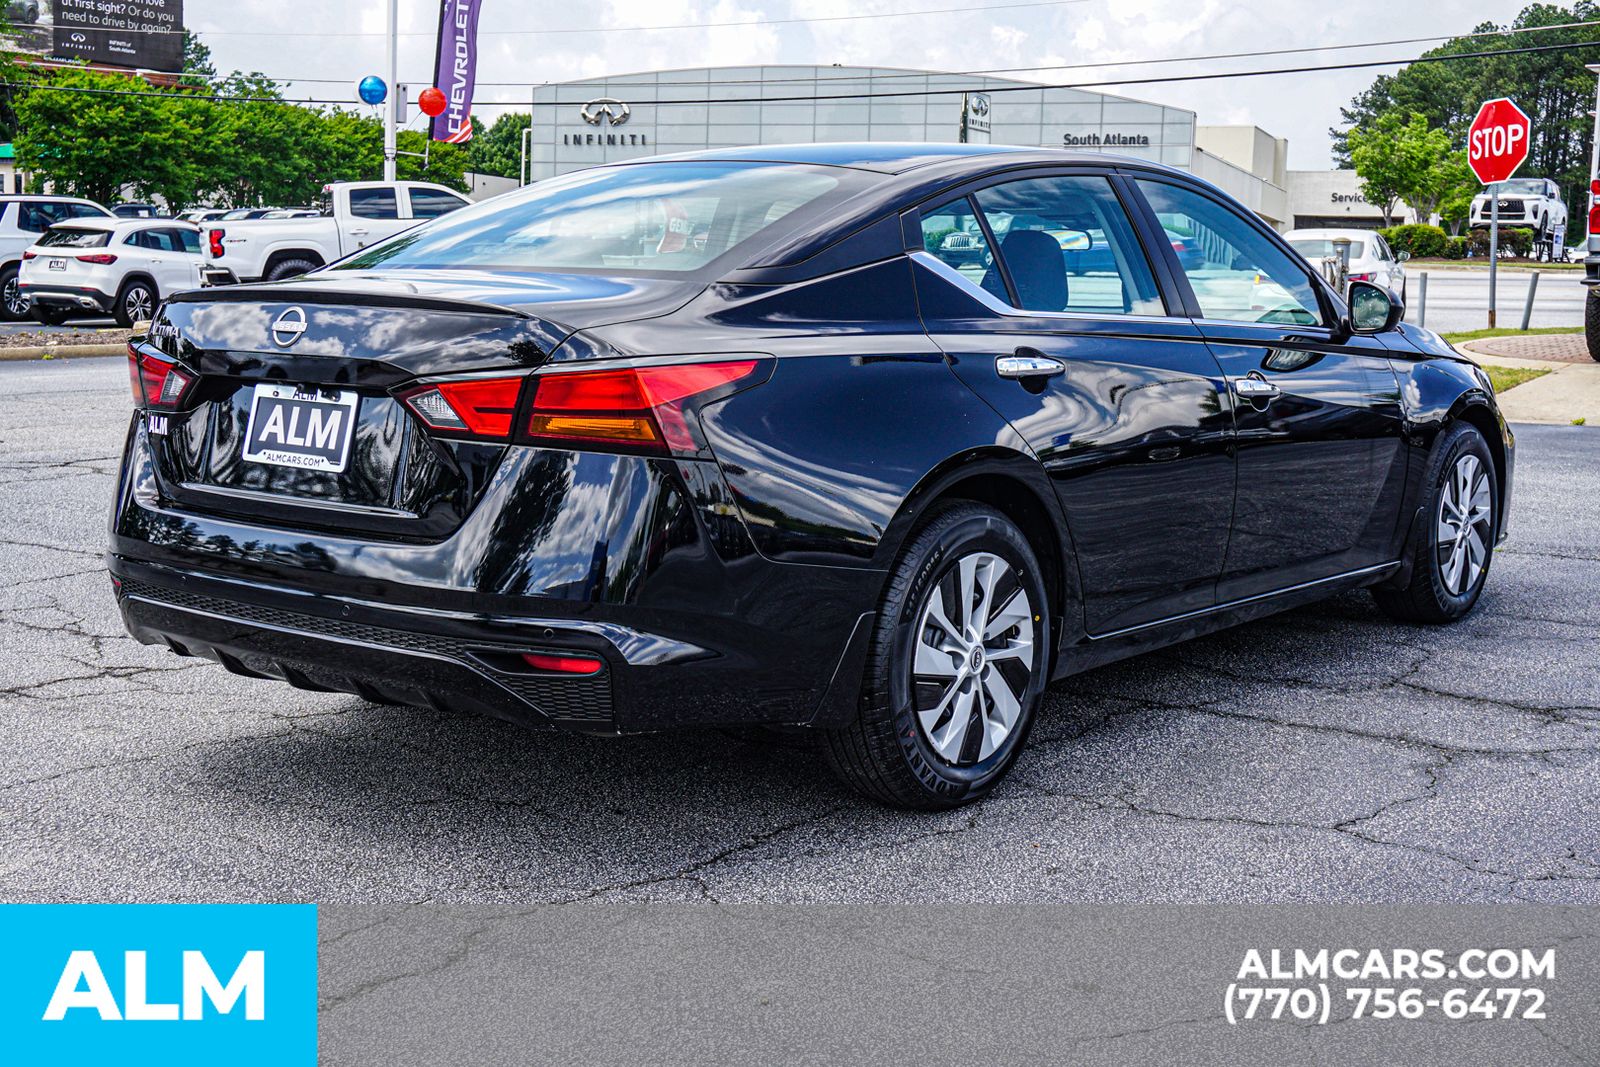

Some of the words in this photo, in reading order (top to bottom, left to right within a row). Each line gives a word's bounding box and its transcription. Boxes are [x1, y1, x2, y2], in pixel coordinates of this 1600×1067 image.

[74, 0, 95, 10] first
[97, 1, 126, 15] sight?
[128, 5, 141, 16] Or
[142, 8, 156, 19] do
[157, 12, 175, 23] you
[62, 11, 87, 23] need
[89, 14, 100, 25] to
[102, 15, 126, 29] drive
[127, 18, 140, 32] by
[141, 23, 172, 35] again?
[61, 42, 96, 51] INFINITI
[447, 0, 470, 134] CHEVROLET
[563, 134, 646, 146] INFINITI
[1063, 133, 1101, 146] South
[1103, 132, 1149, 145] Atlanta
[1471, 124, 1524, 161] STOP
[1331, 192, 1367, 203] Service
[149, 414, 168, 436] ALM
[258, 404, 343, 450] ALM
[266, 453, 321, 468] ALMCARS.COM
